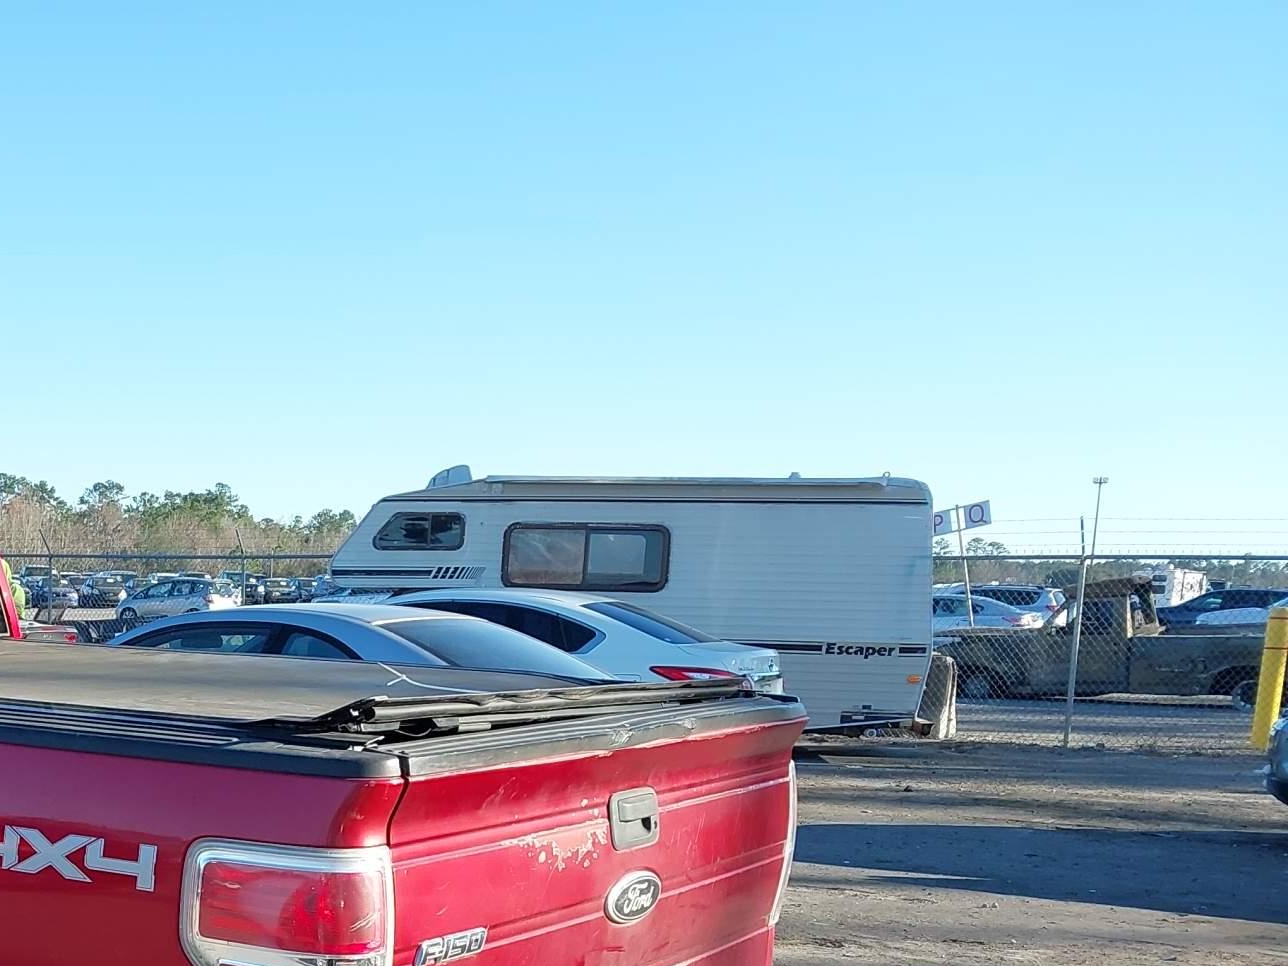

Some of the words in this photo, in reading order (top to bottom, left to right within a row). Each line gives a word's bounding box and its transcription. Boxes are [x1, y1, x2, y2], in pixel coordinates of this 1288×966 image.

[968, 503, 987, 524] Q
[824, 642, 896, 660] Escaper
[623, 881, 655, 914] Ford
